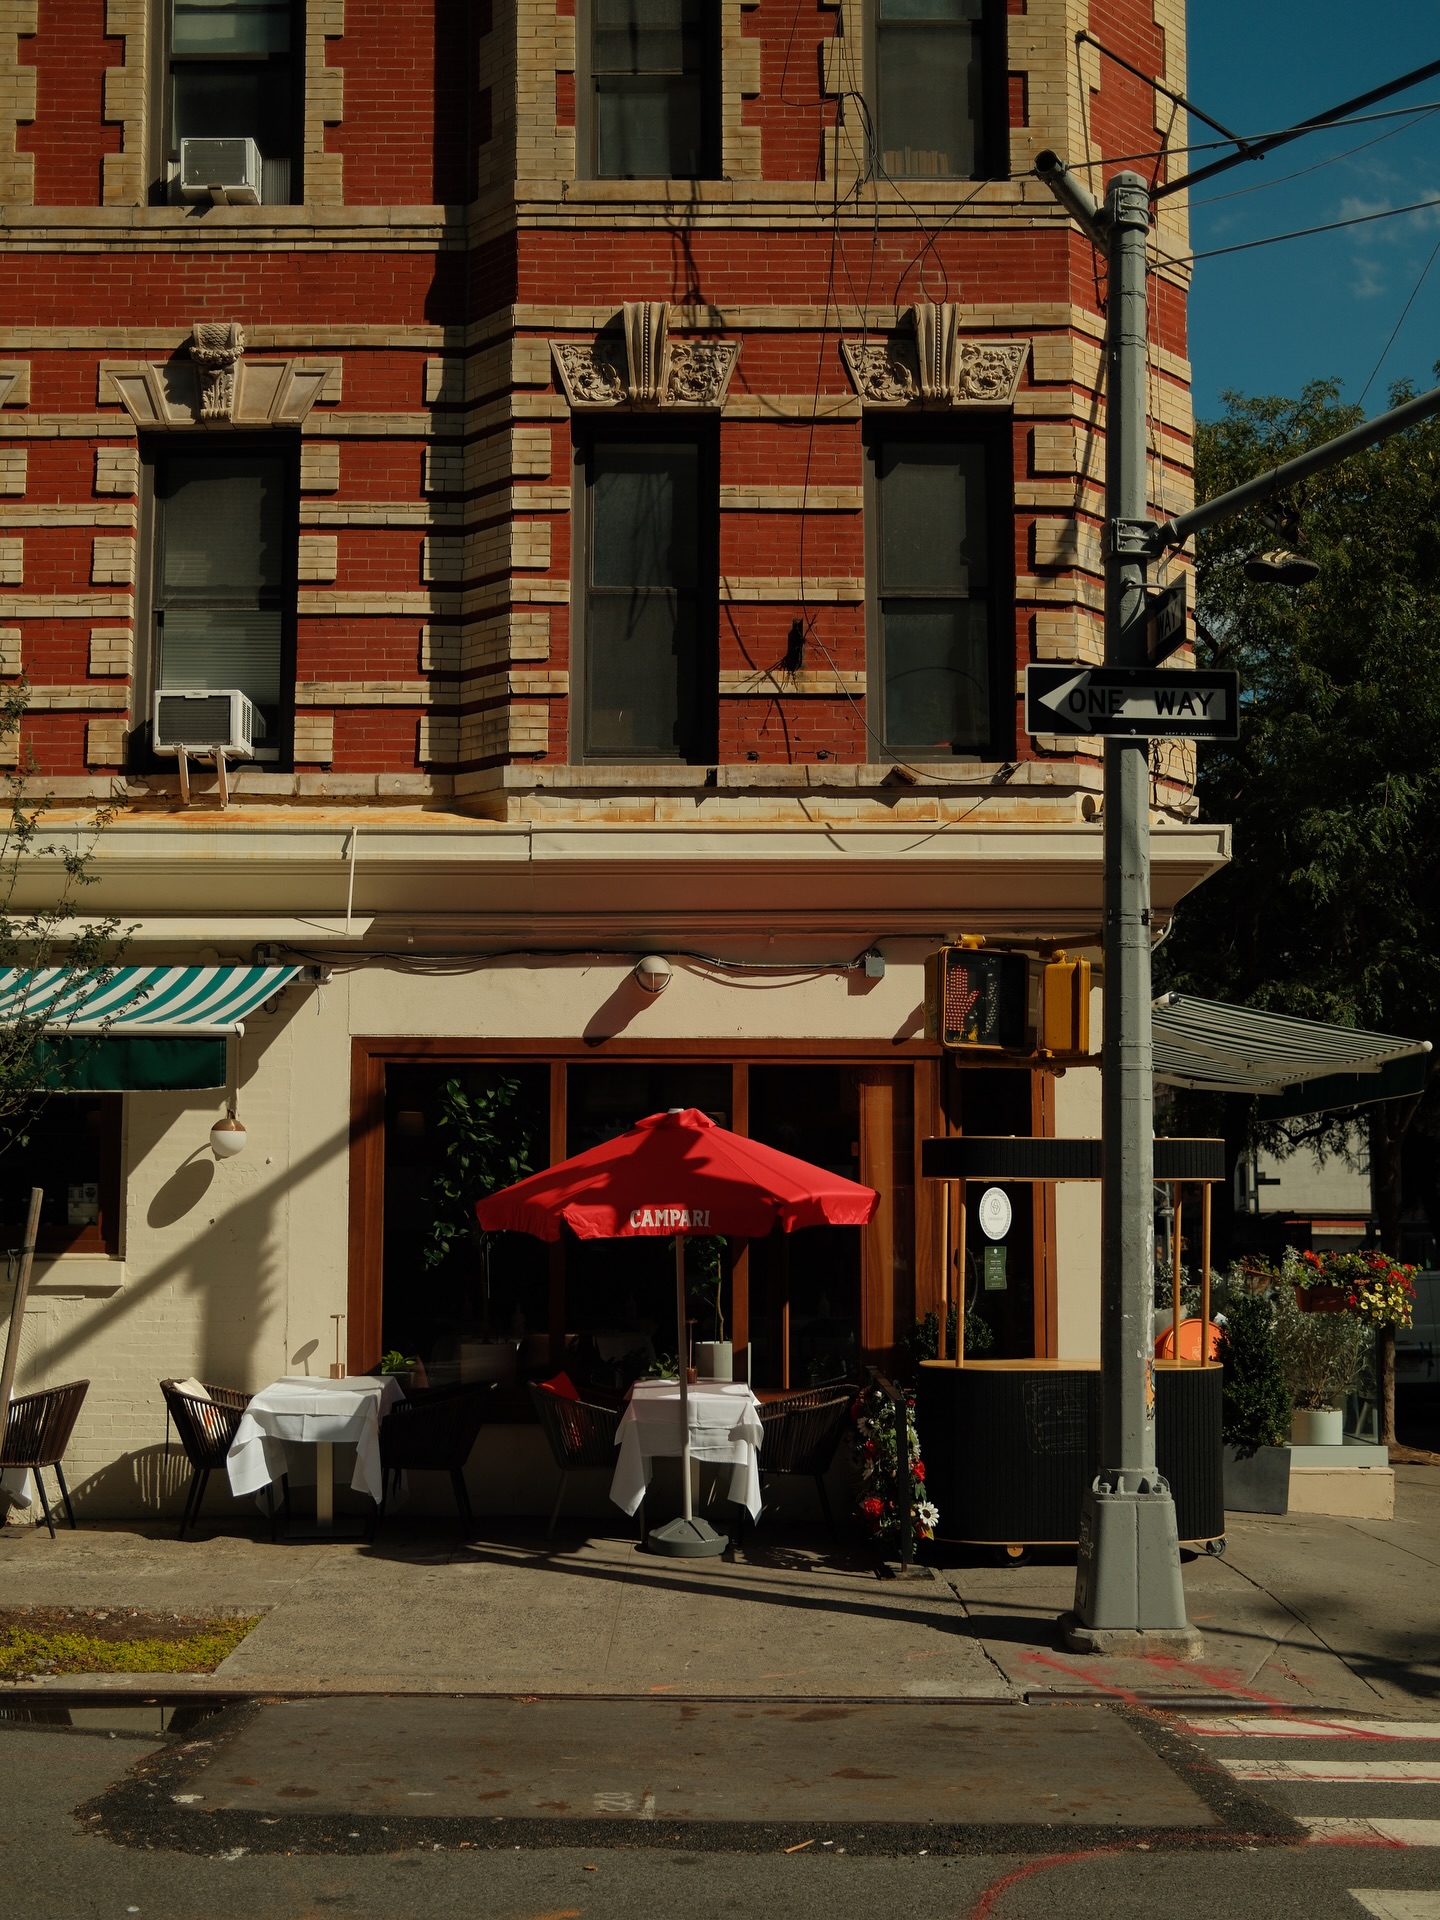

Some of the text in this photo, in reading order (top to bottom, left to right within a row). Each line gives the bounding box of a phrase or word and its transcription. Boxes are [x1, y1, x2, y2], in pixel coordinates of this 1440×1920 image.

[1157, 602, 1178, 640] WAY
[1068, 688, 1215, 716] ONE WAY
[629, 1209, 711, 1229] CAMPARI
